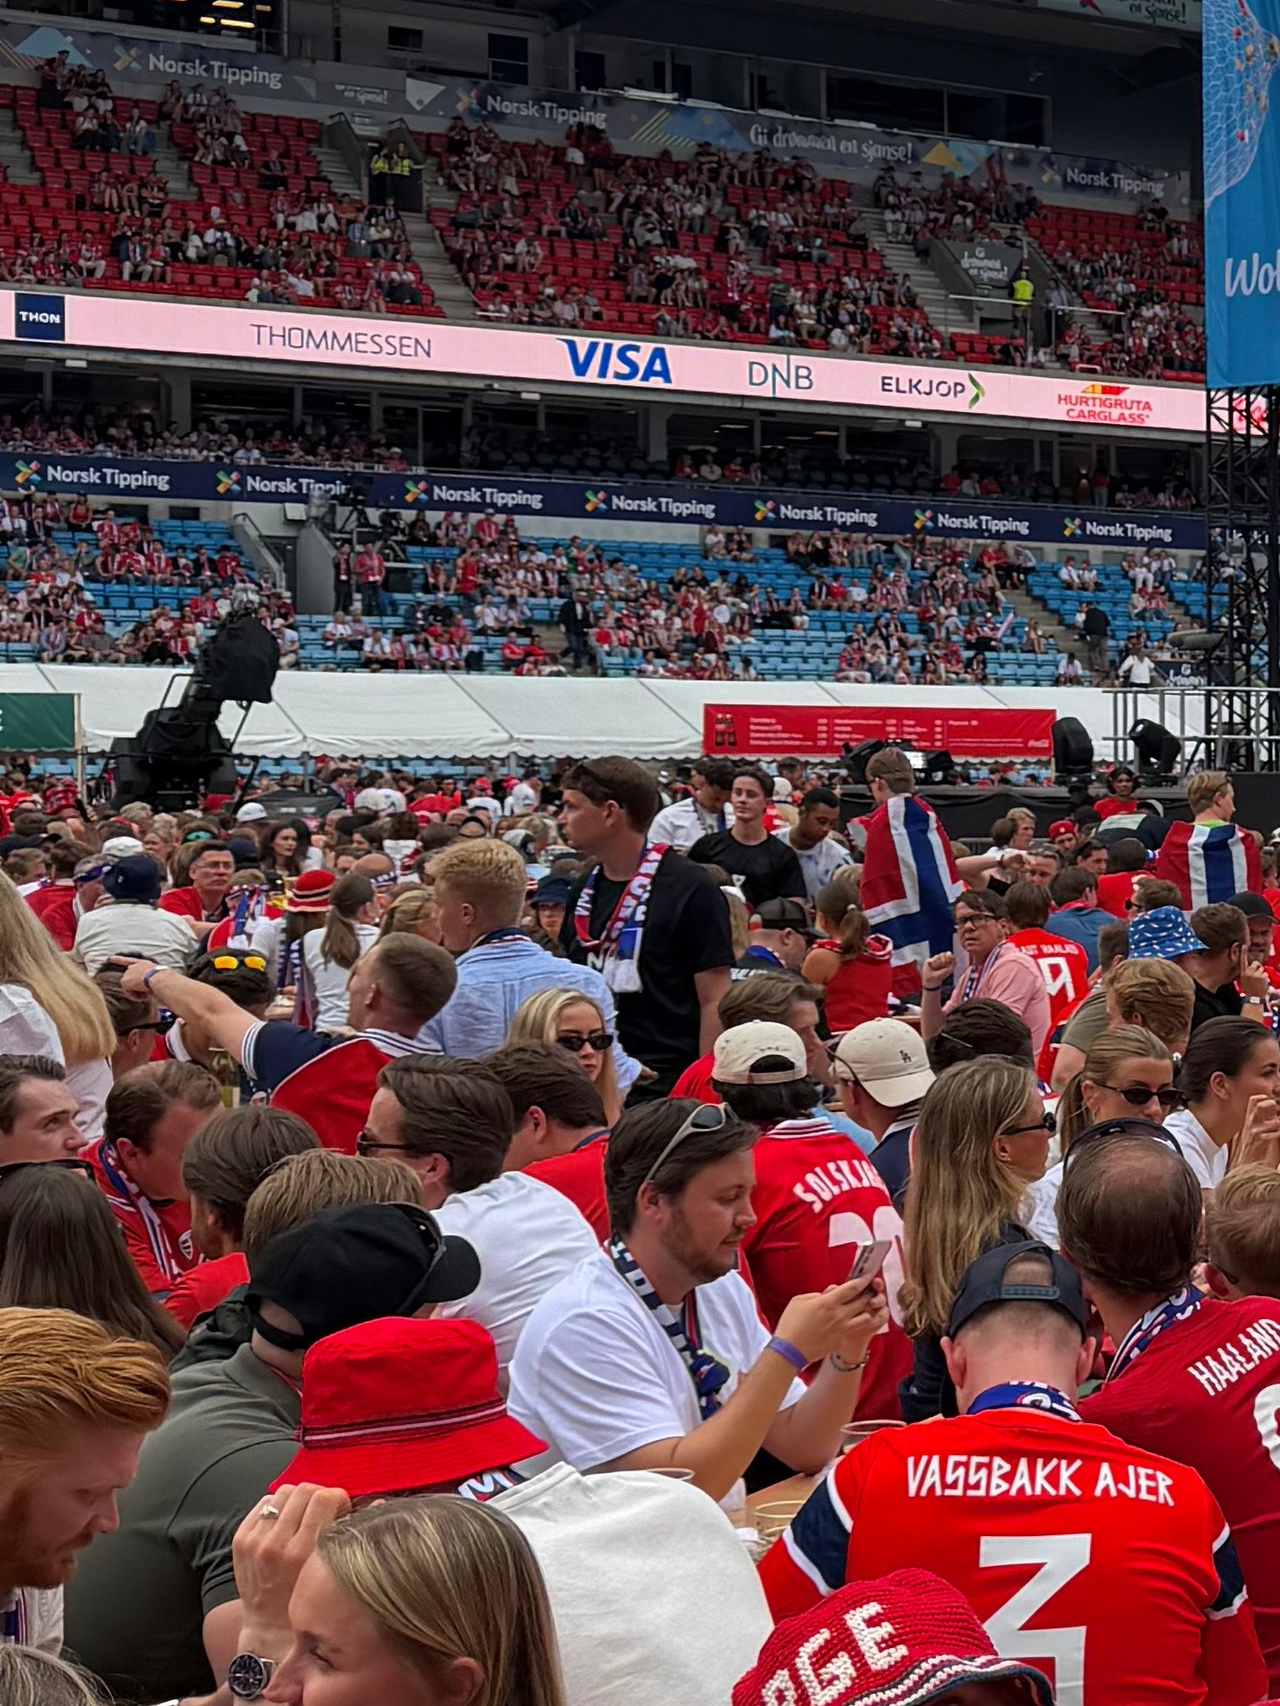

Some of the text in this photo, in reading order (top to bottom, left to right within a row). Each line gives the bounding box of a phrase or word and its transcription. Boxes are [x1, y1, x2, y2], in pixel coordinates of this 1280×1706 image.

[148, 53, 282, 90] Norsk Tipping
[486, 95, 607, 129] Norsk Tipping
[1066, 168, 1165, 198] Norsk Tipping
[20, 310, 61, 325] THON
[250, 323, 433, 359] THOMMESSEN
[557, 337, 672, 384] VISA
[748, 354, 813, 398] DNB
[1057, 394, 1152, 414] HURTIGRUTA
[47, 465, 170, 491] Norsk Tipping
[433, 485, 543, 510] Norsk Tipping
[907, 1456, 1083, 1498] VASSBAKK
